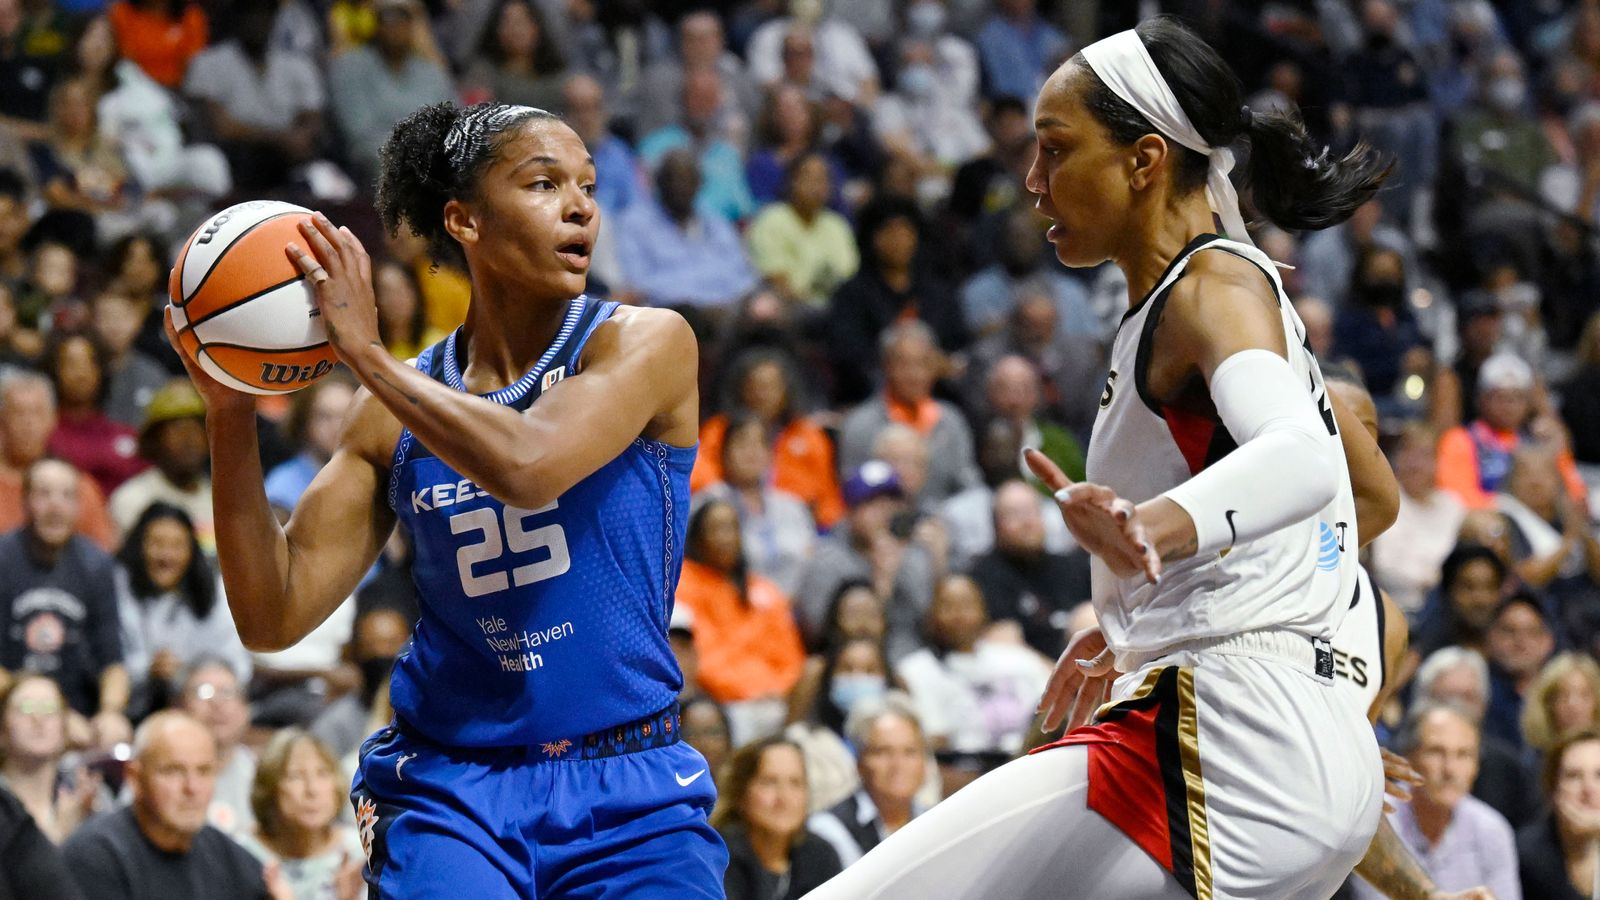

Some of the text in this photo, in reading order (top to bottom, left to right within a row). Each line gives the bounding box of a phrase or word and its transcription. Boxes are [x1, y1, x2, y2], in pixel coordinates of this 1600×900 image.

[450, 498, 571, 598] 25
[475, 615, 508, 635] Yale
[498, 651, 544, 672] Health
